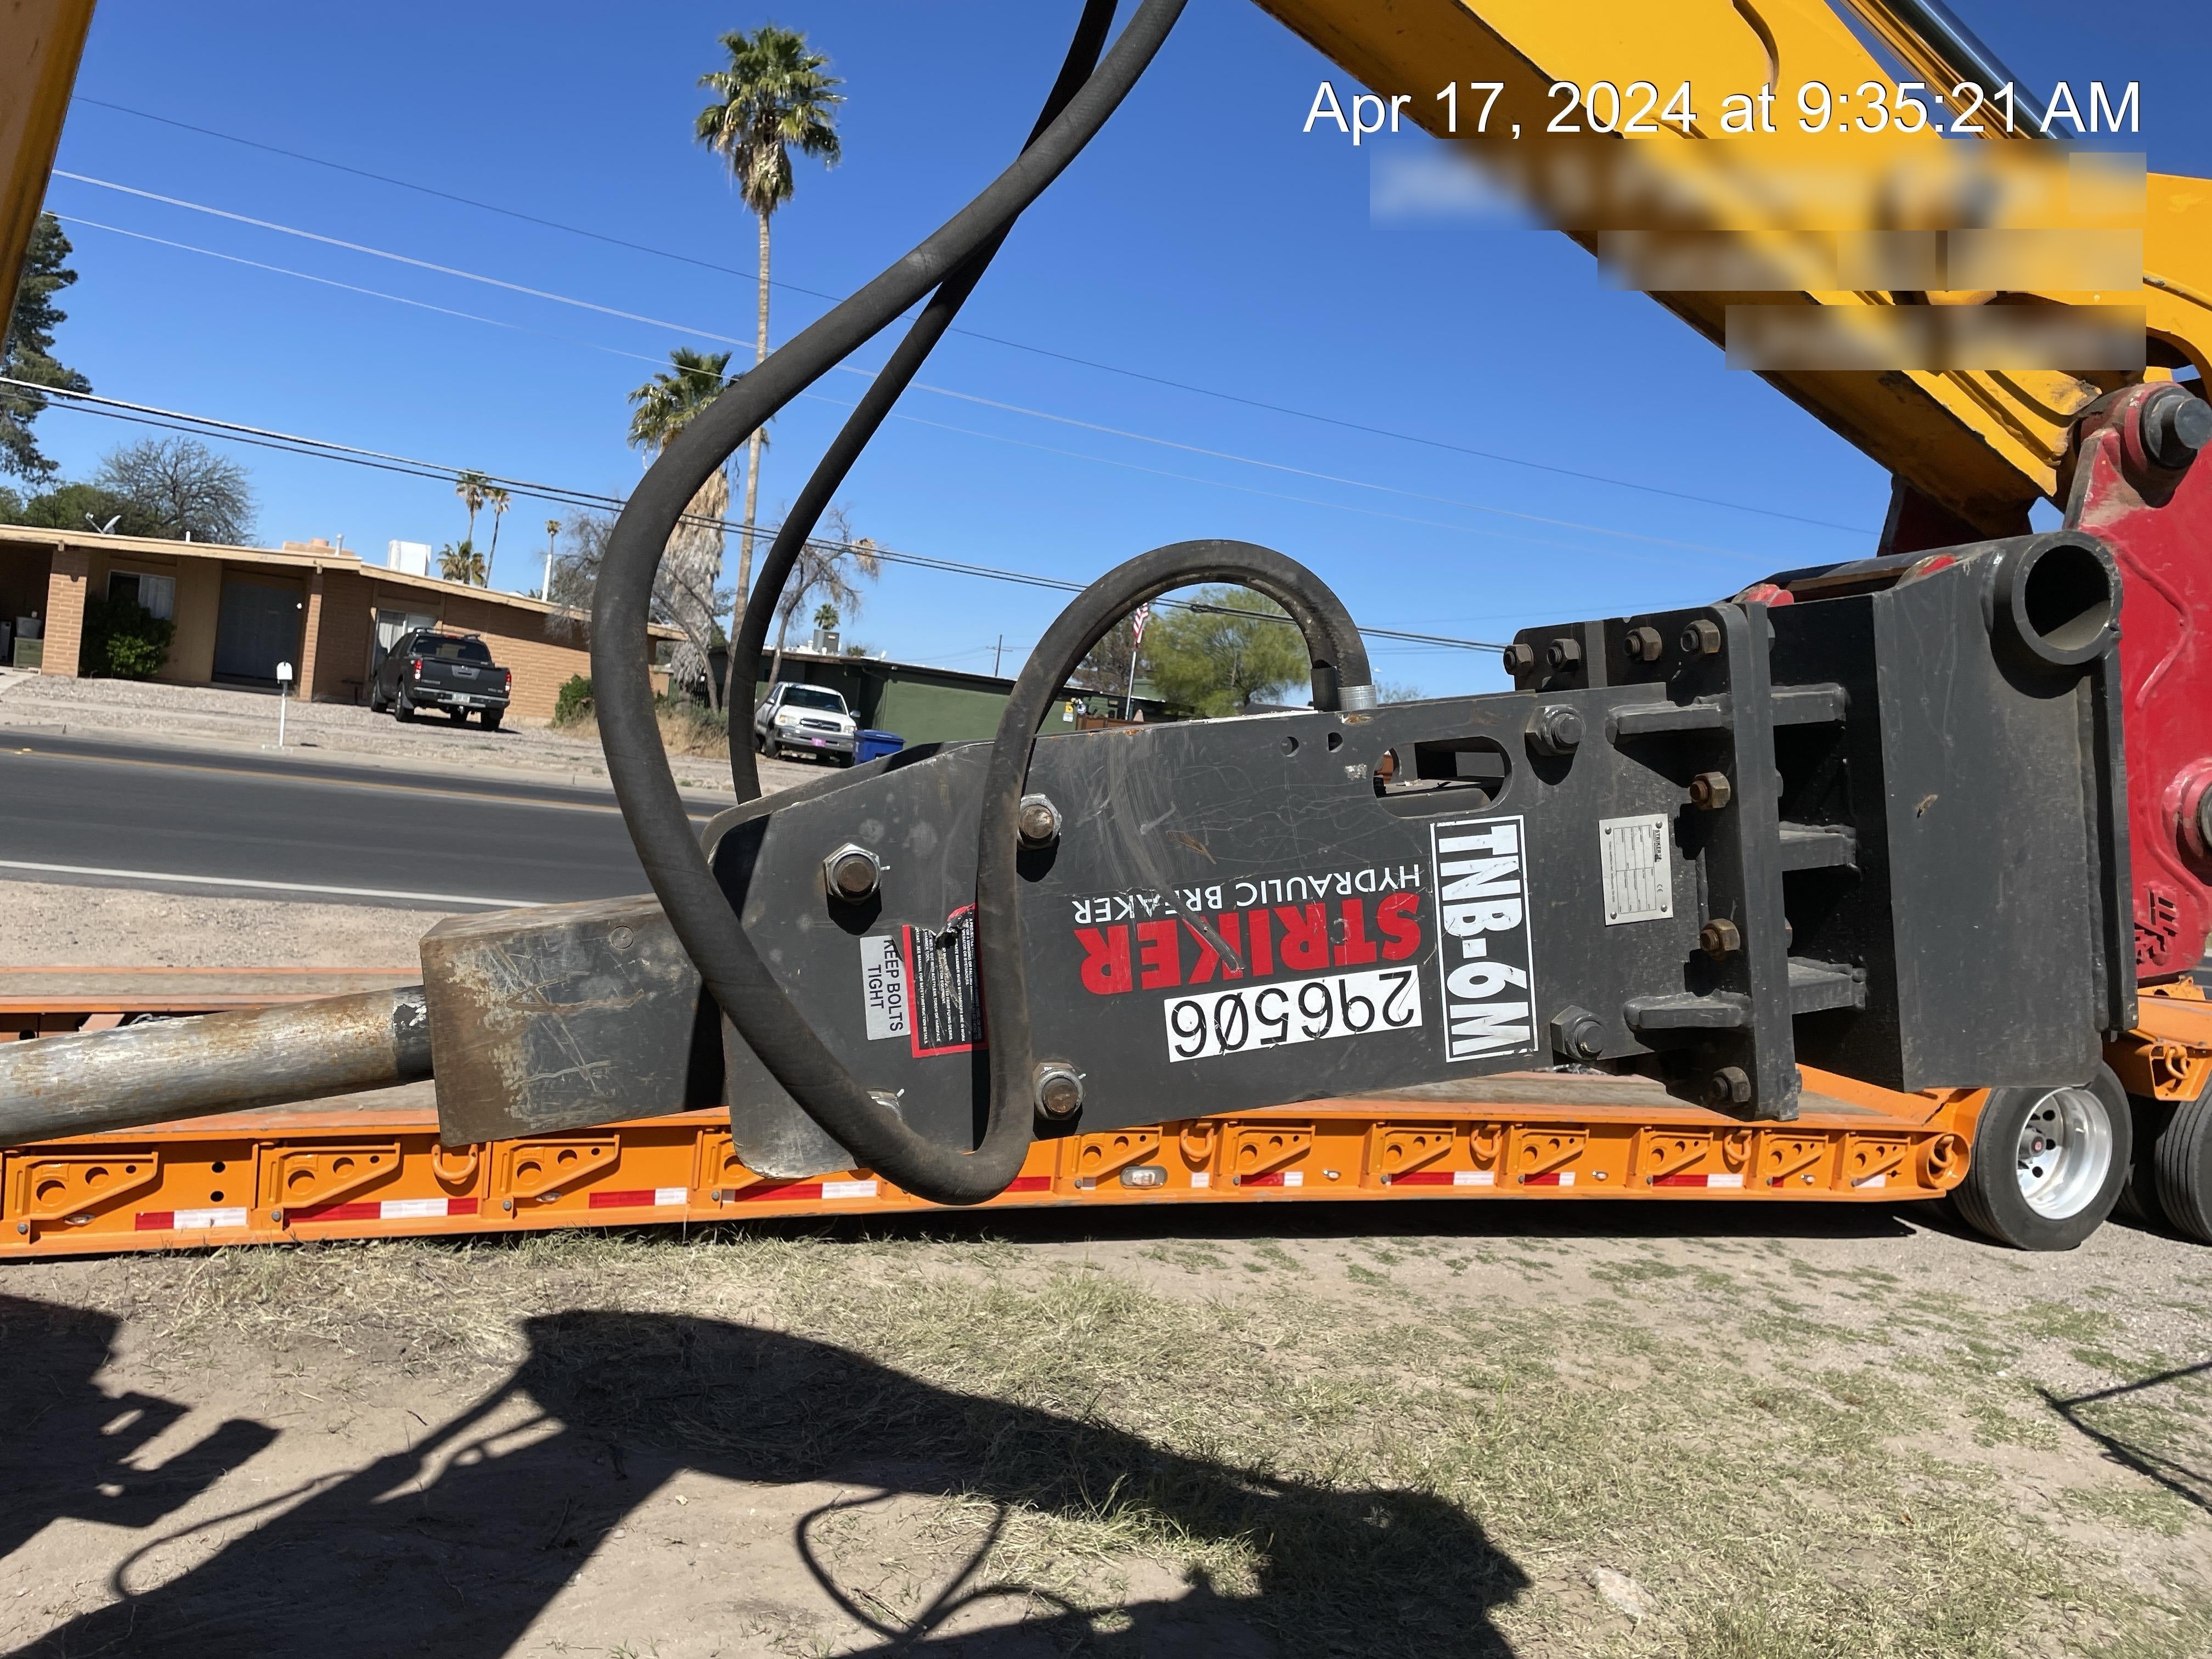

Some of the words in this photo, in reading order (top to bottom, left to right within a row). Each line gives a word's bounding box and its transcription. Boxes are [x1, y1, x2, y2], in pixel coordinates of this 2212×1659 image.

[1236, 864, 1421, 906] HYDRAULIC
[883, 939, 900, 979] KEEP
[1073, 892, 1421, 995] STRIKER
[1438, 824, 1531, 1056] TNB-6M
[867, 964, 884, 1009] TIGHT
[887, 983, 904, 1032] BOLTS
[1171, 970, 1415, 1058] 296506
